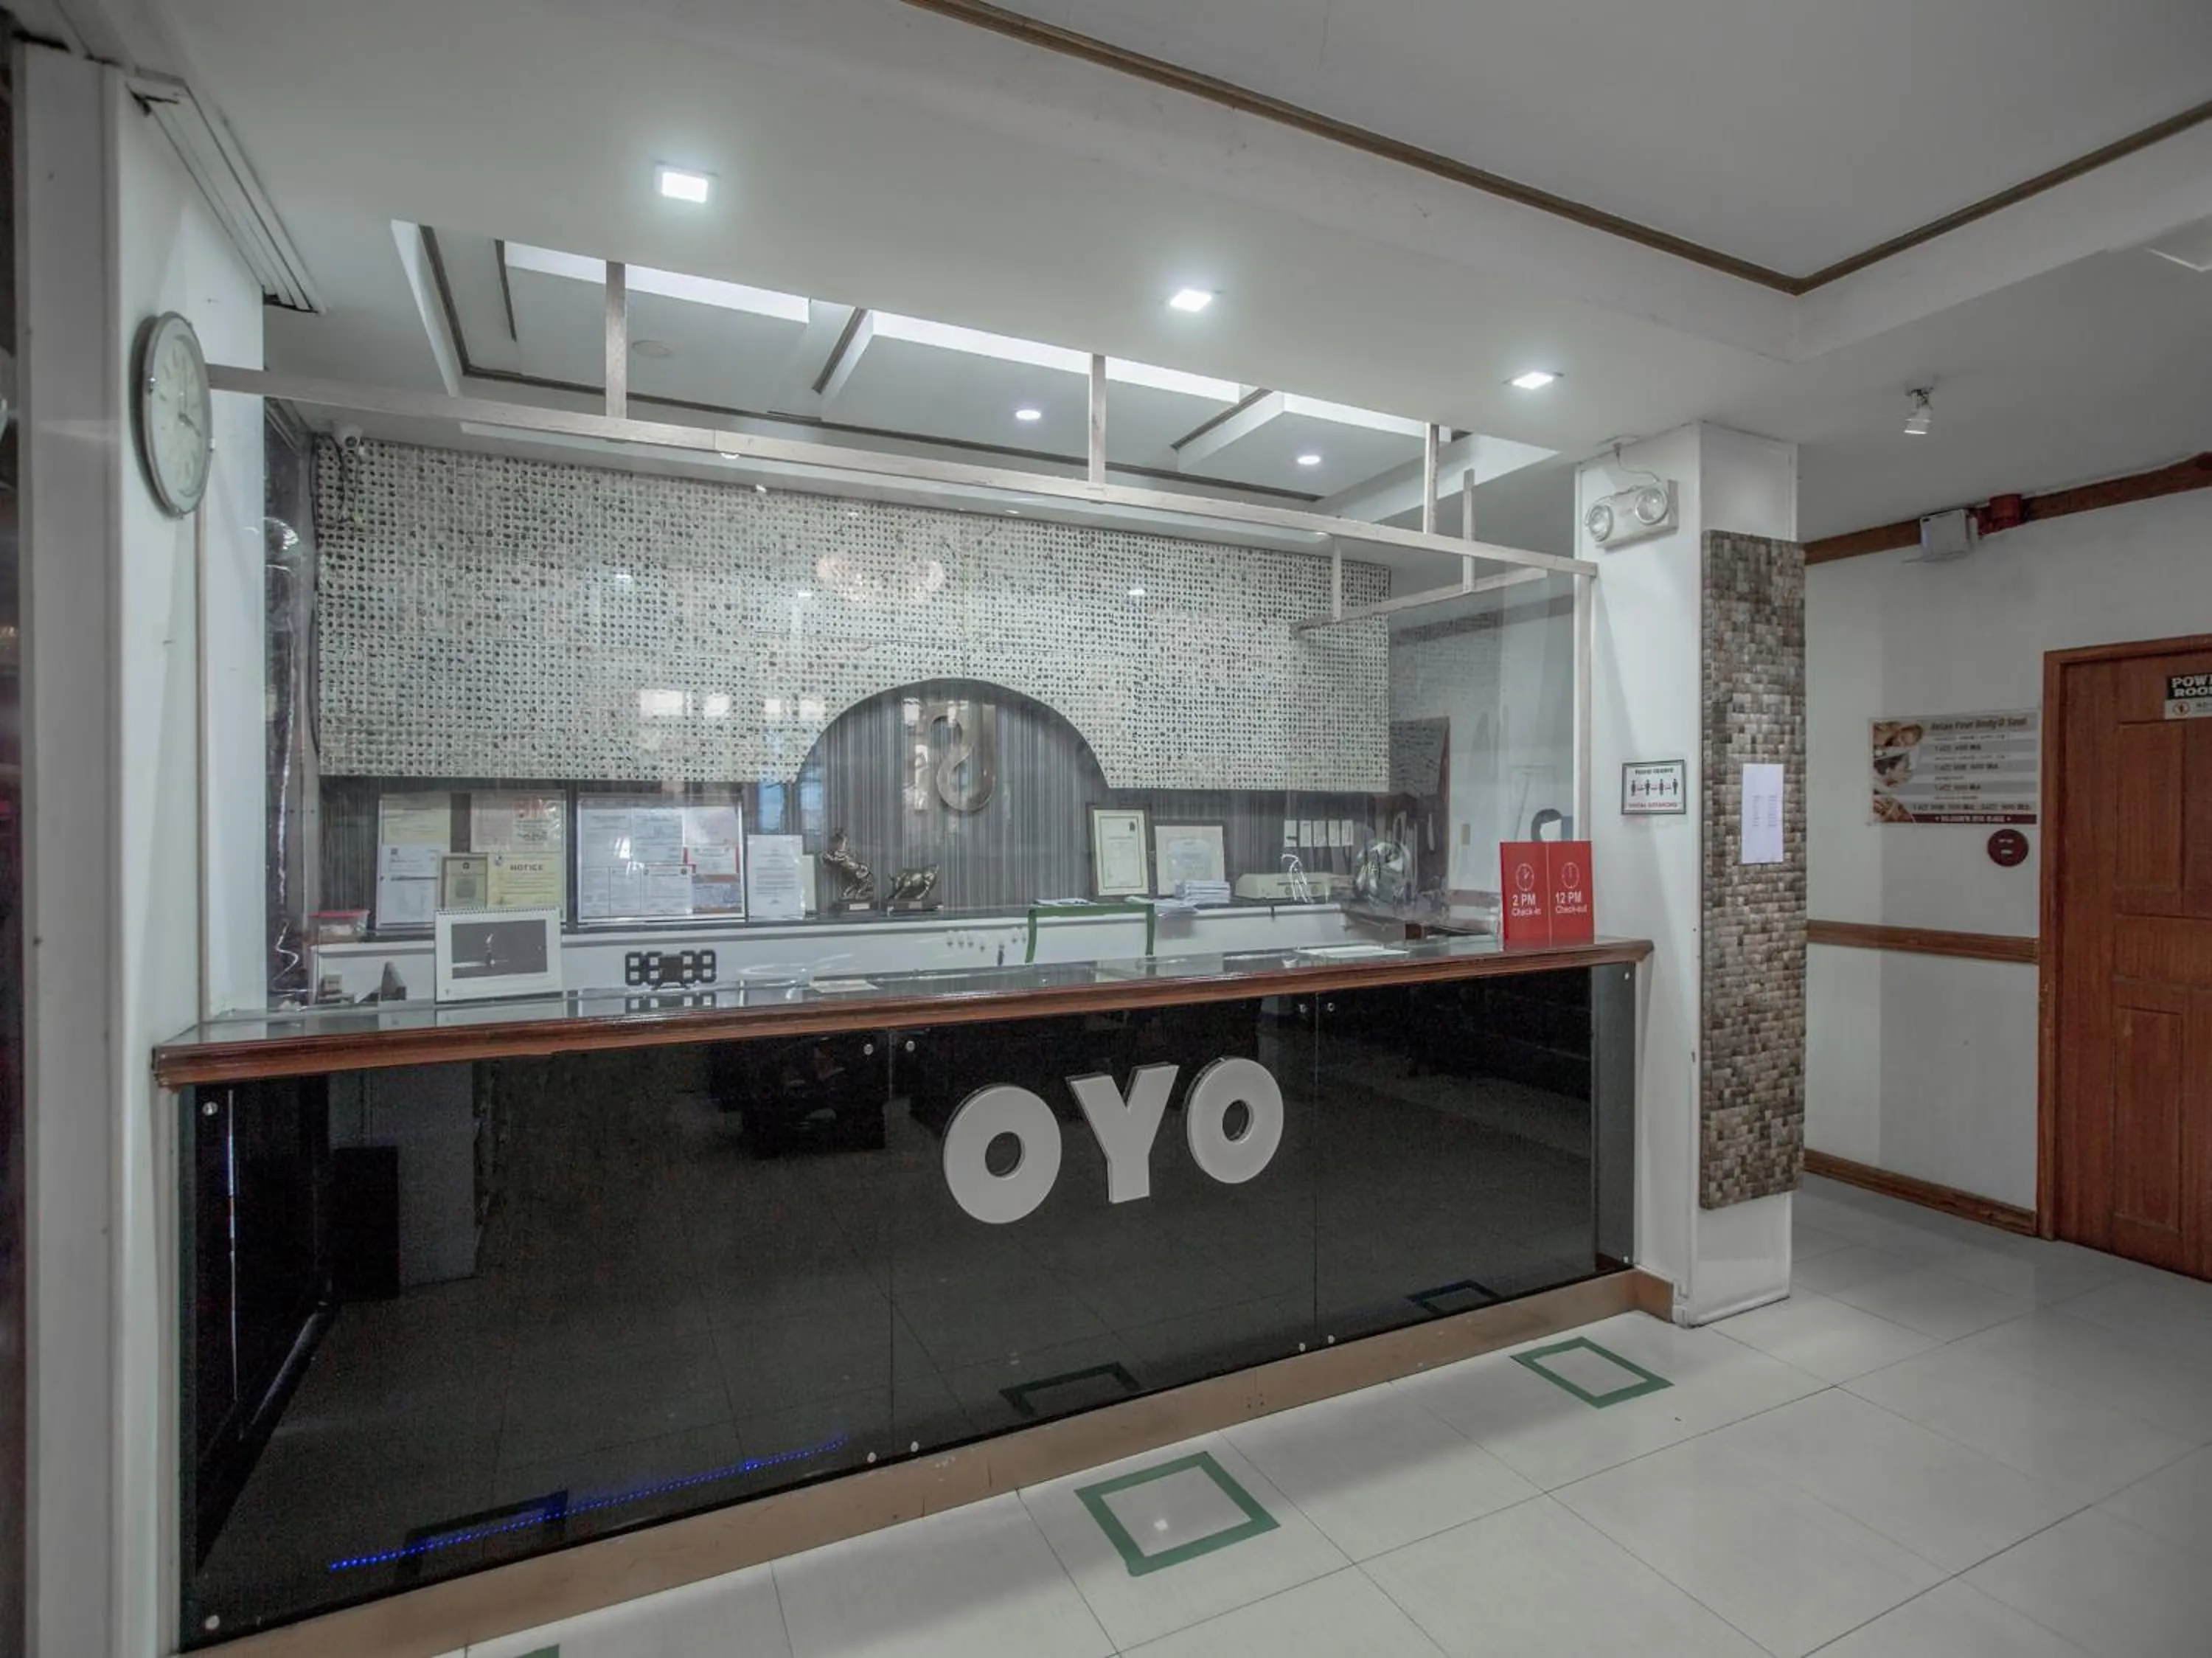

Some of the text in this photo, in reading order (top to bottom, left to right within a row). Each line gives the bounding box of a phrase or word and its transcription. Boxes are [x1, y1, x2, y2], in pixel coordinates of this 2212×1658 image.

[2171, 674, 2212, 688] POW
[2174, 686, 2212, 697] ROO
[1512, 893, 1536, 906] 2 PM
[1556, 891, 1582, 904] 12 PM
[943, 1057, 1284, 1224] OYO
